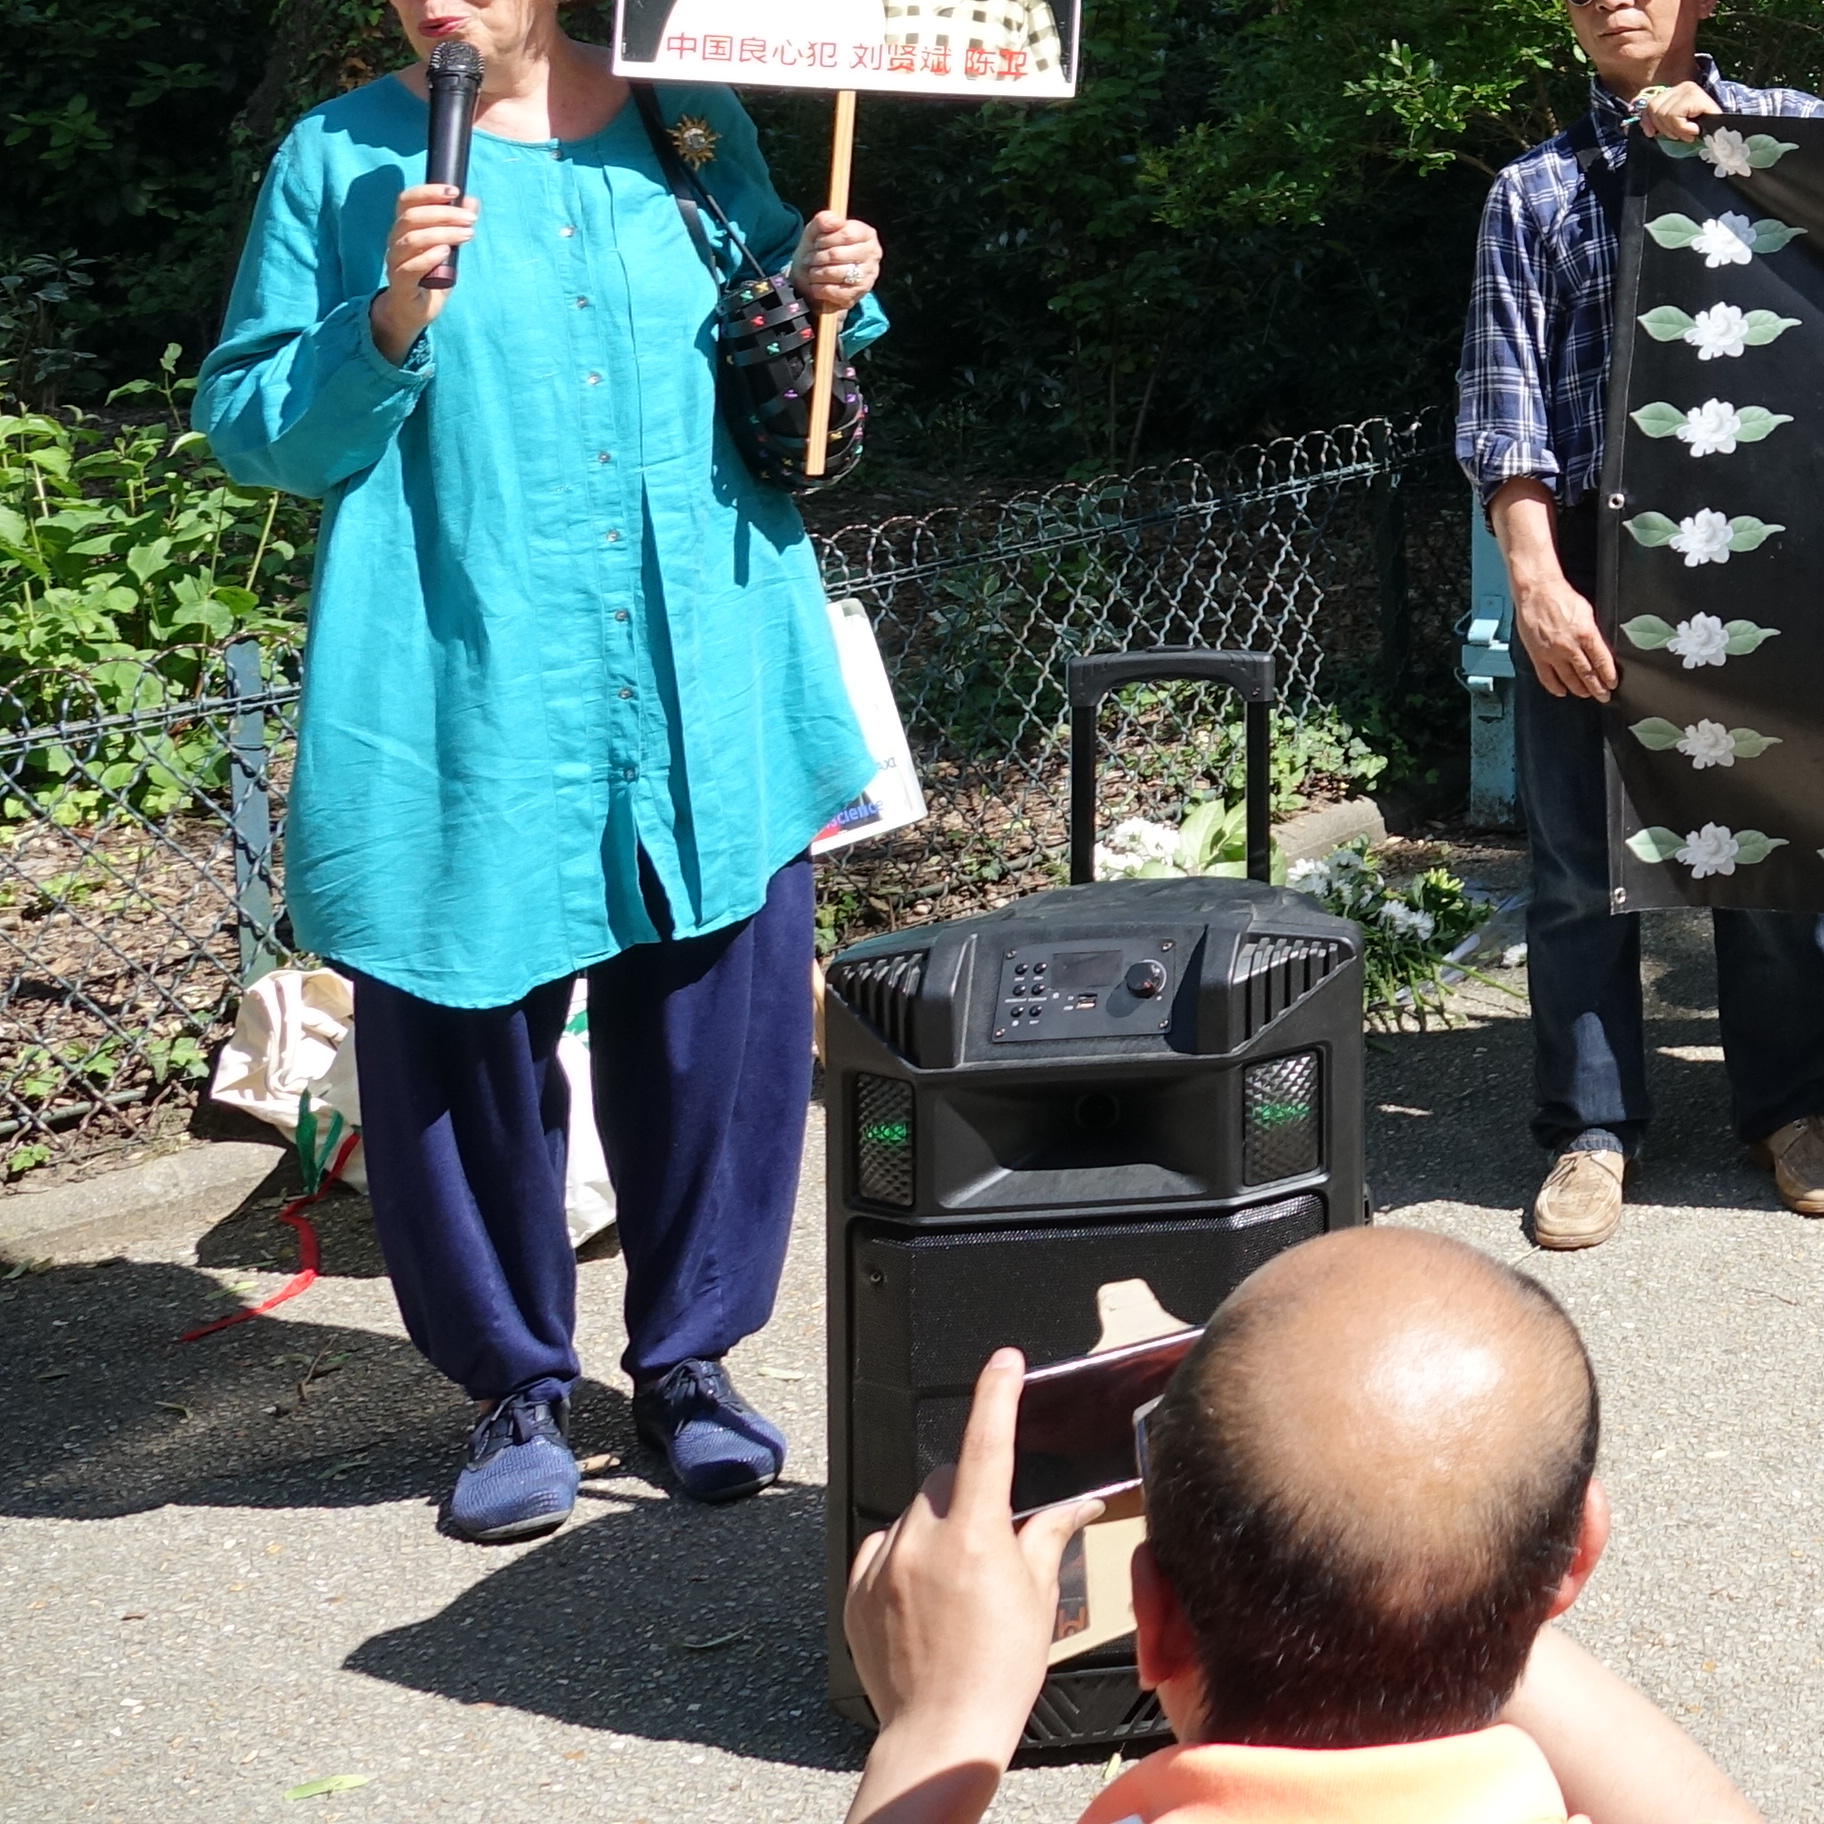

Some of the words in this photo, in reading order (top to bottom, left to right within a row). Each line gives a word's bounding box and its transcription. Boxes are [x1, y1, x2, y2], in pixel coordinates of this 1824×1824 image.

[667, 32, 838, 69] 中国良心犯
[850, 42, 952, 75] 刘贤斌
[964, 48, 1029, 80] 陈卫
